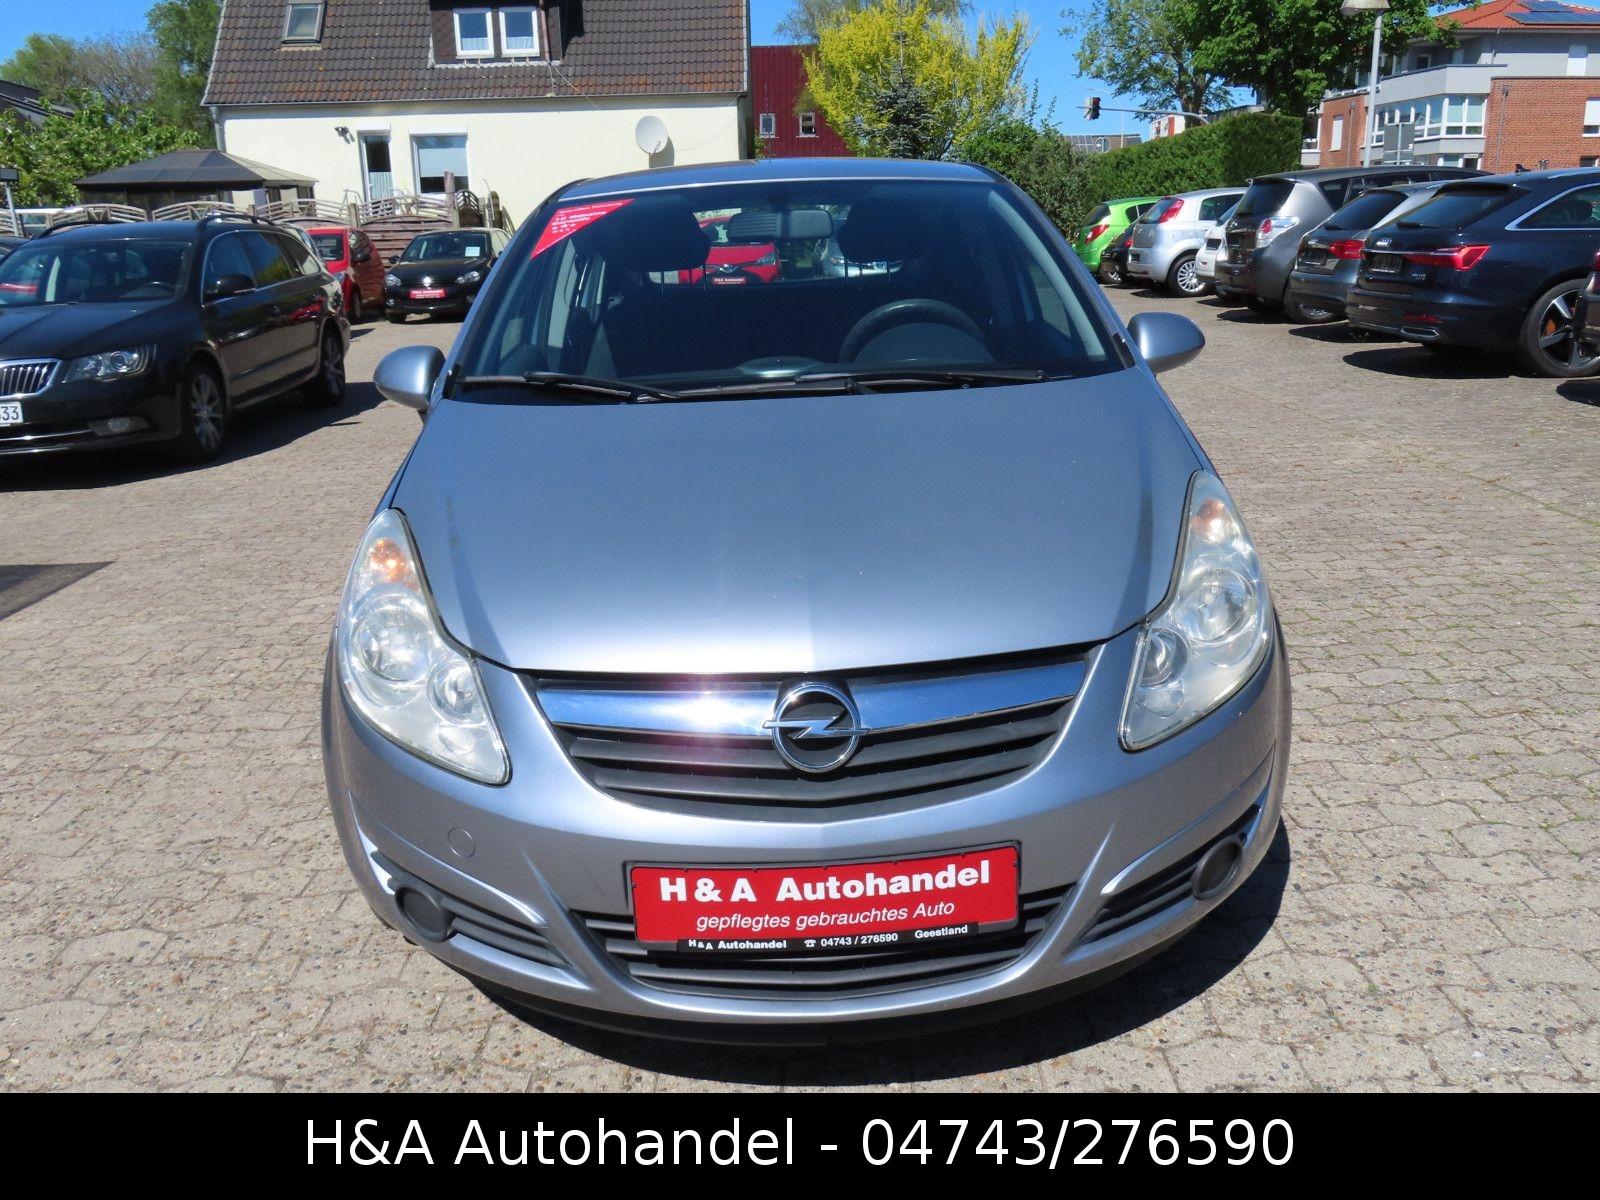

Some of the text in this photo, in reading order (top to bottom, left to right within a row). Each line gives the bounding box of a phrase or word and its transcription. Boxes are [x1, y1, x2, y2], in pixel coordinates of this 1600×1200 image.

[775, 859, 990, 902] Autohandel
[696, 901, 956, 932] gepflegtes gebrauchtes Auto
[717, 939, 787, 950] Autohandel
[914, 924, 969, 940] Geestland
